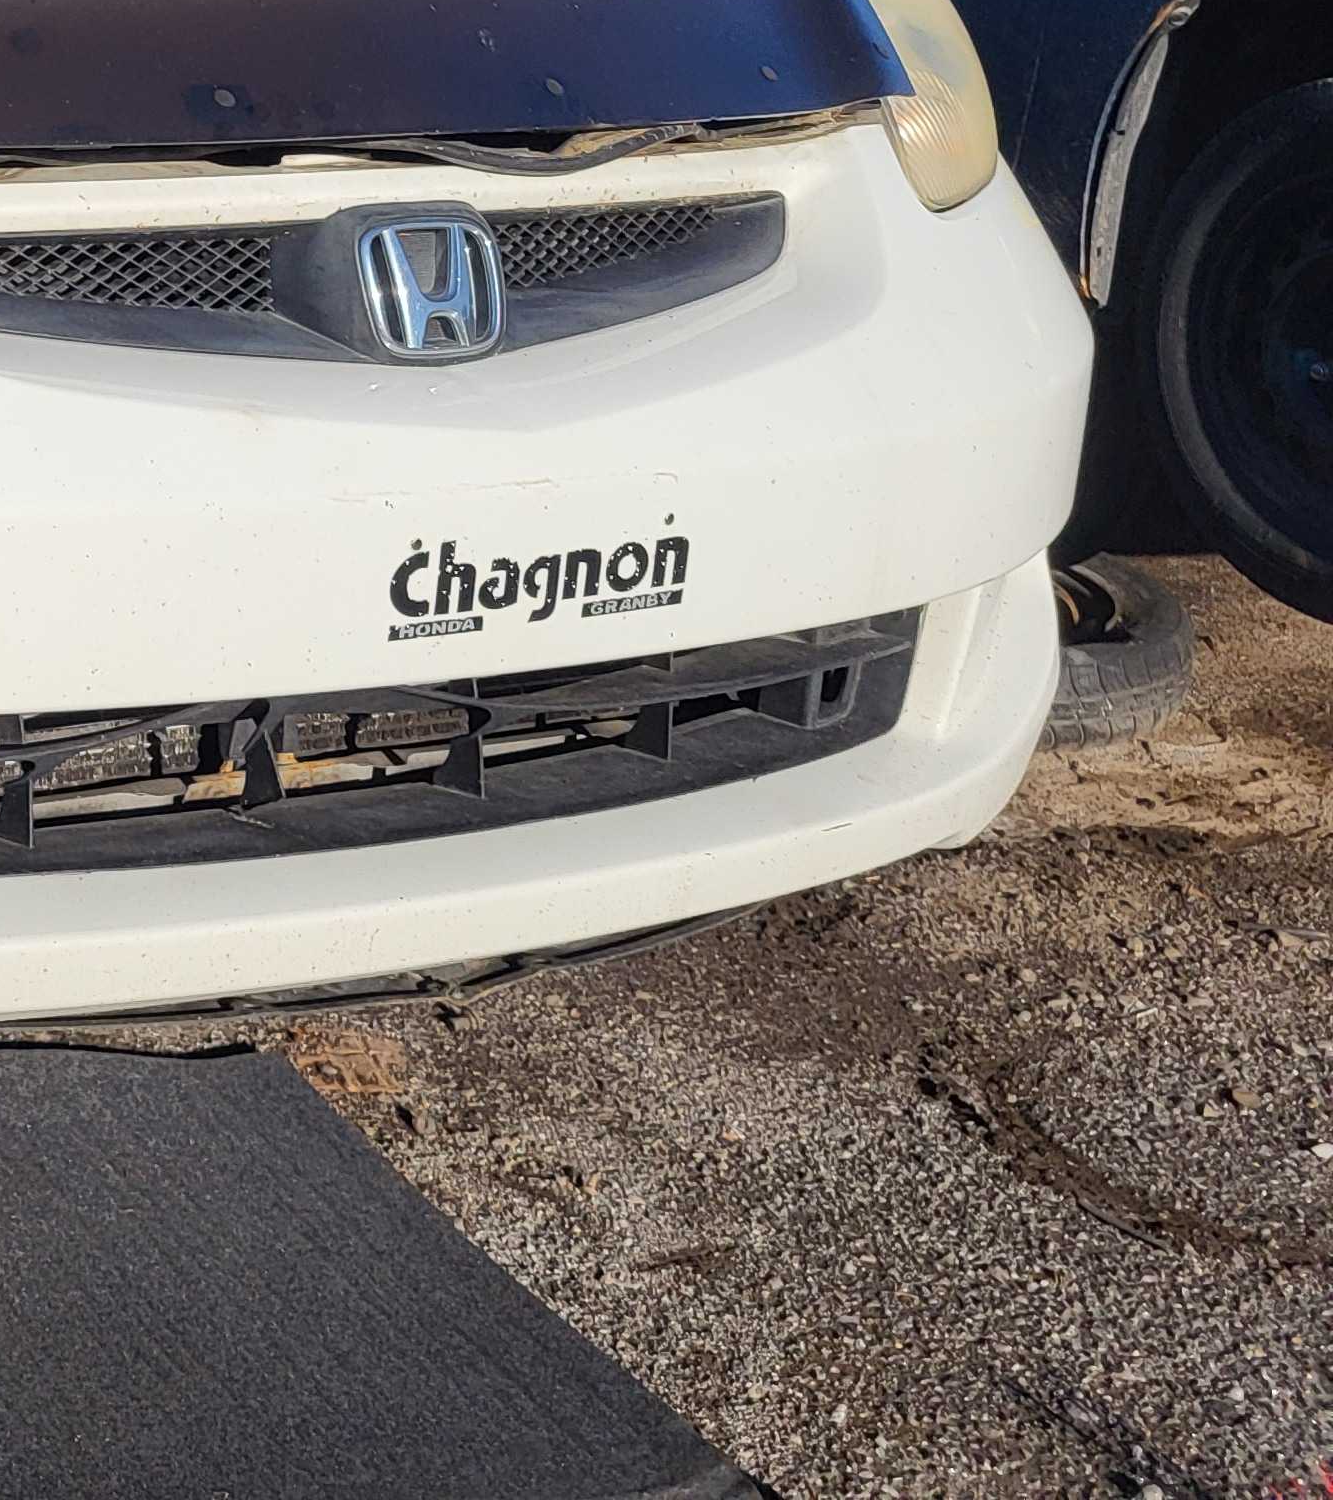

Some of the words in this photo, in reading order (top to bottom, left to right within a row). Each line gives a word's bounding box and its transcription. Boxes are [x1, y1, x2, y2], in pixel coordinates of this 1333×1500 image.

[389, 536, 690, 623] Chagnon
[589, 591, 673, 616] GRANBY
[397, 618, 477, 639] HONDA
